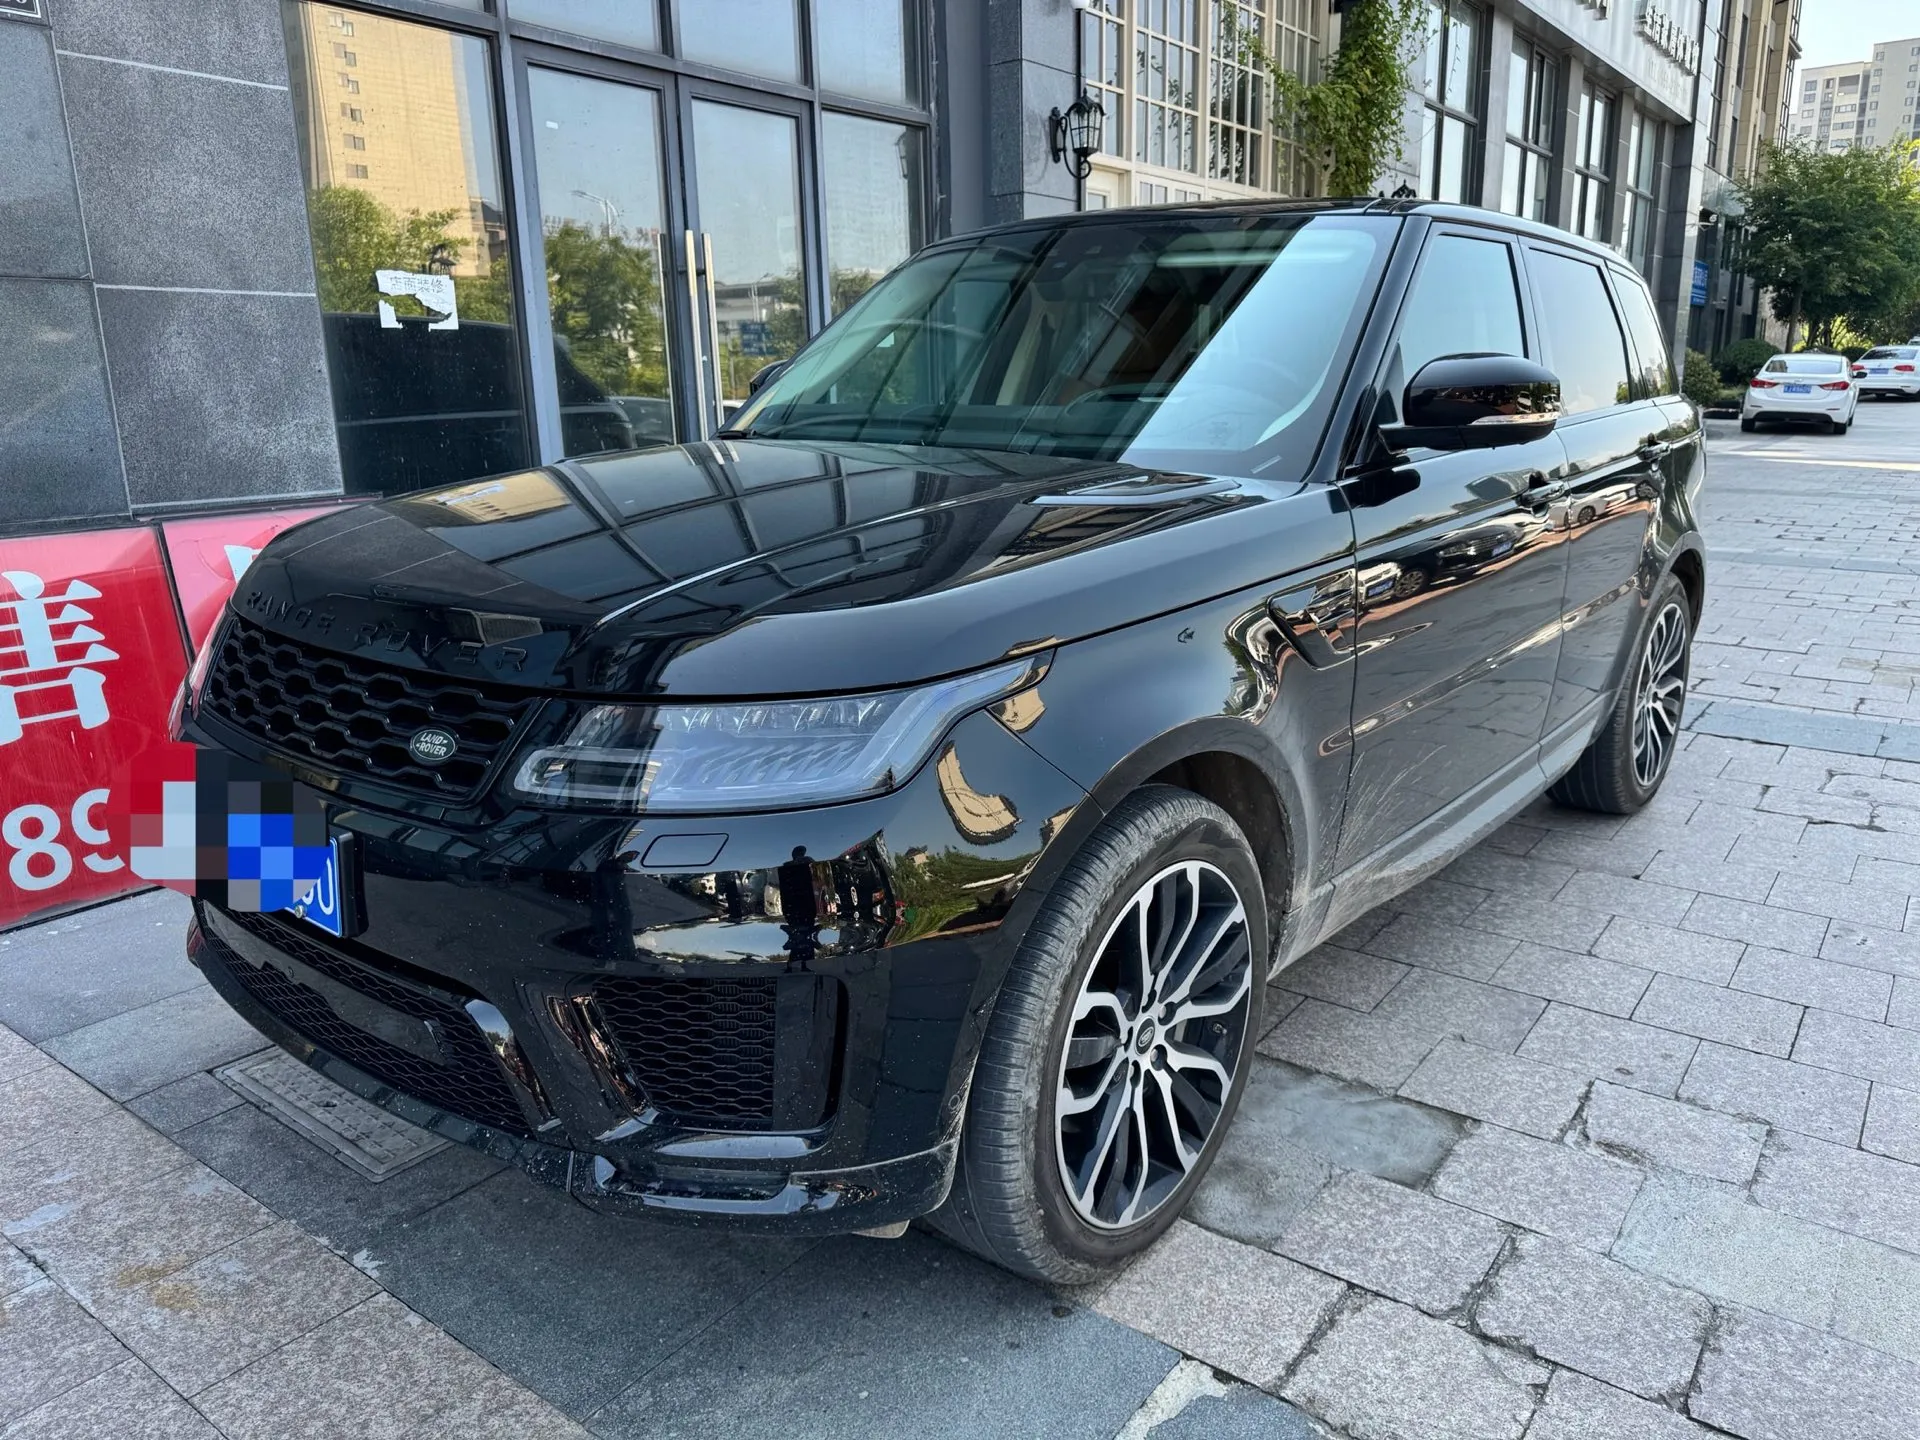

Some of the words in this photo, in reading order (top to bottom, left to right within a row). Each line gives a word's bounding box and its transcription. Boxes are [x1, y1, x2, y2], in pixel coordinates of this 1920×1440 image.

[249, 591, 335, 634] RANGE
[354, 622, 528, 671] ROVER
[420, 732, 444, 745] LAND
[418, 742, 447, 756] ROVER
